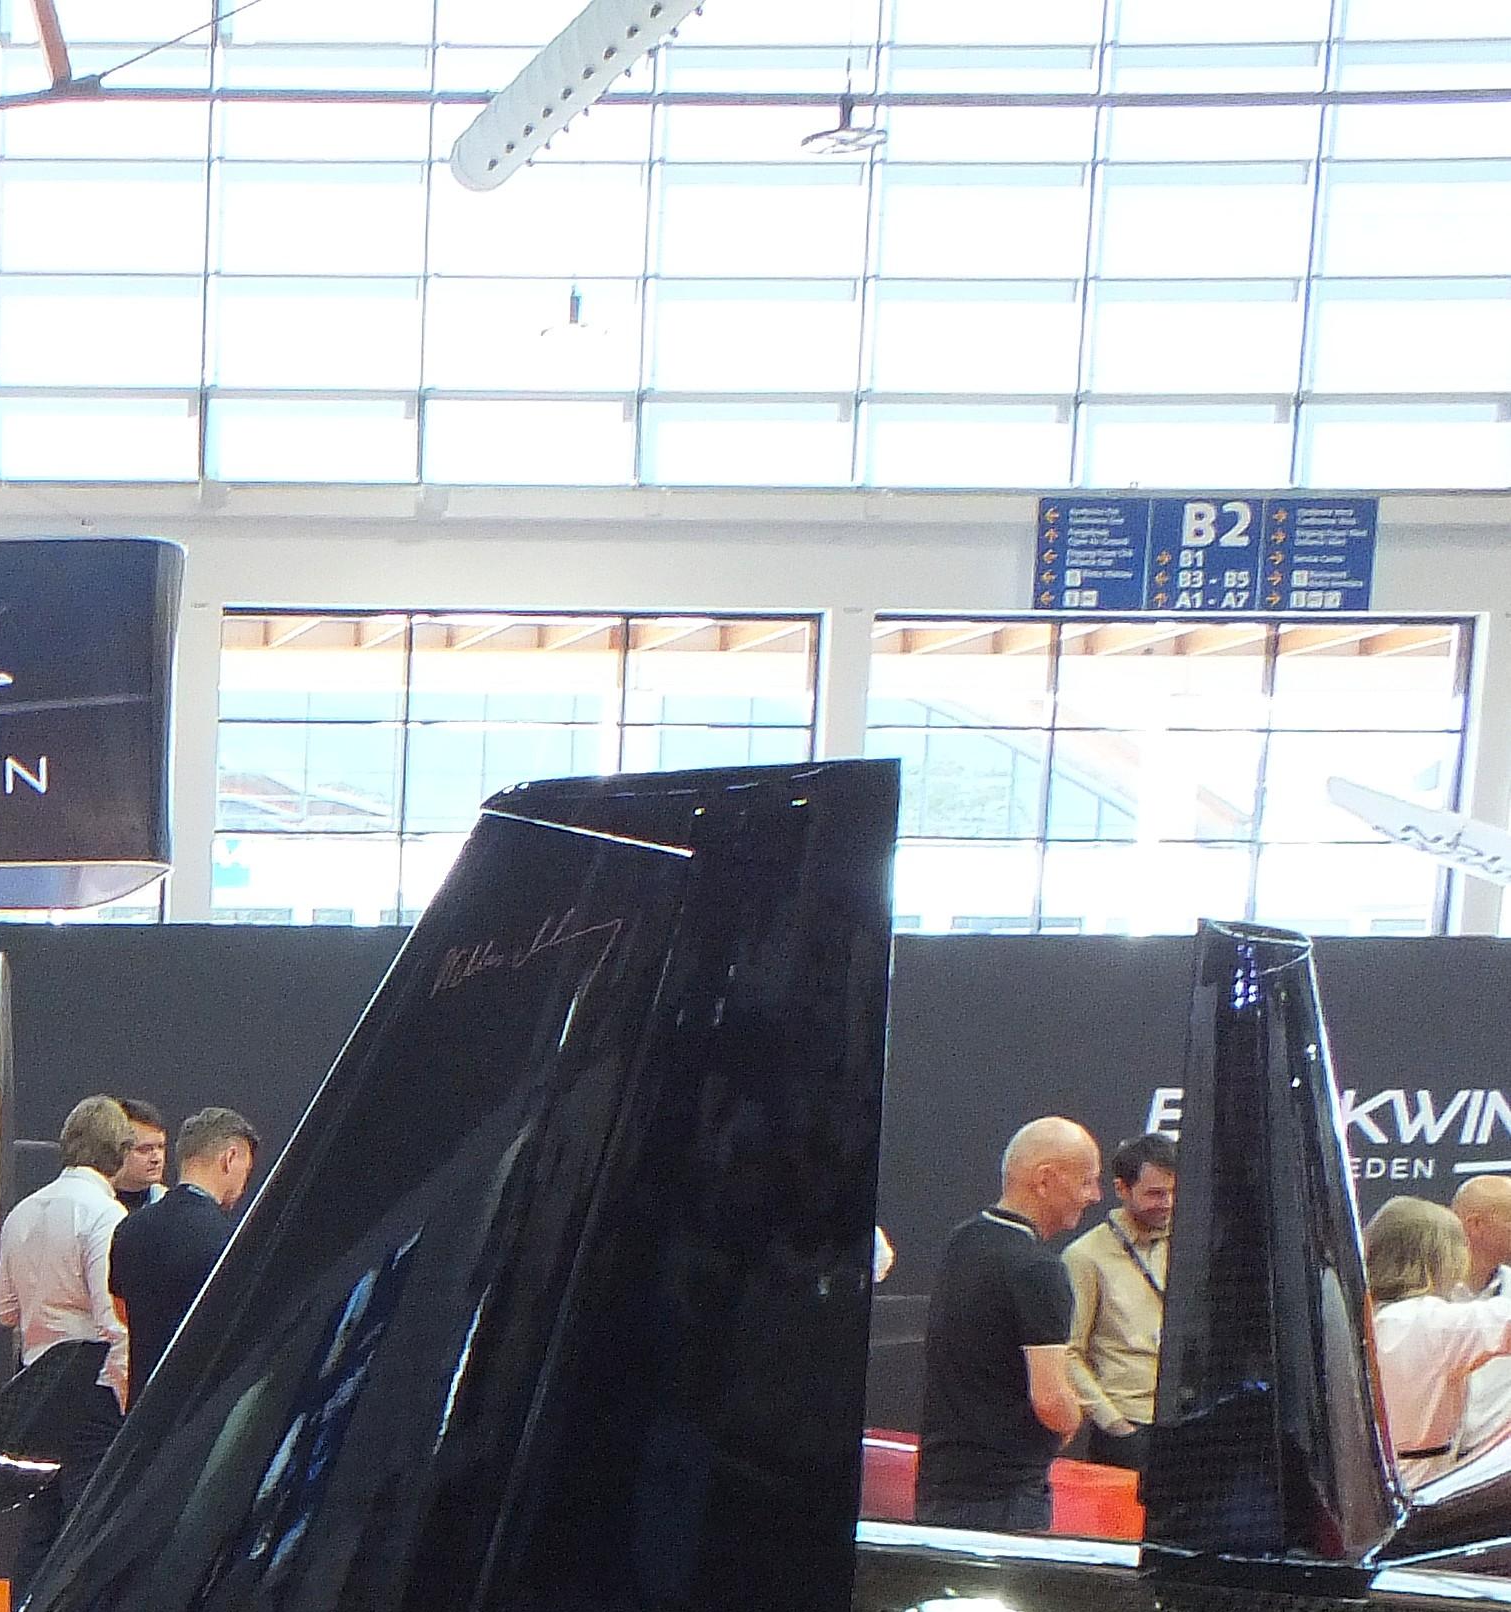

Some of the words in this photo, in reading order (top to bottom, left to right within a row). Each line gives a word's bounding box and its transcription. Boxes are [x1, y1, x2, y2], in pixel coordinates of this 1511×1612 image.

[1182, 502, 1251, 547] B2
[1179, 549, 1204, 568] B1
[1178, 570, 1204, 588] B3
[1174, 591, 1203, 608] A1
[1220, 591, 1250, 608] A7
